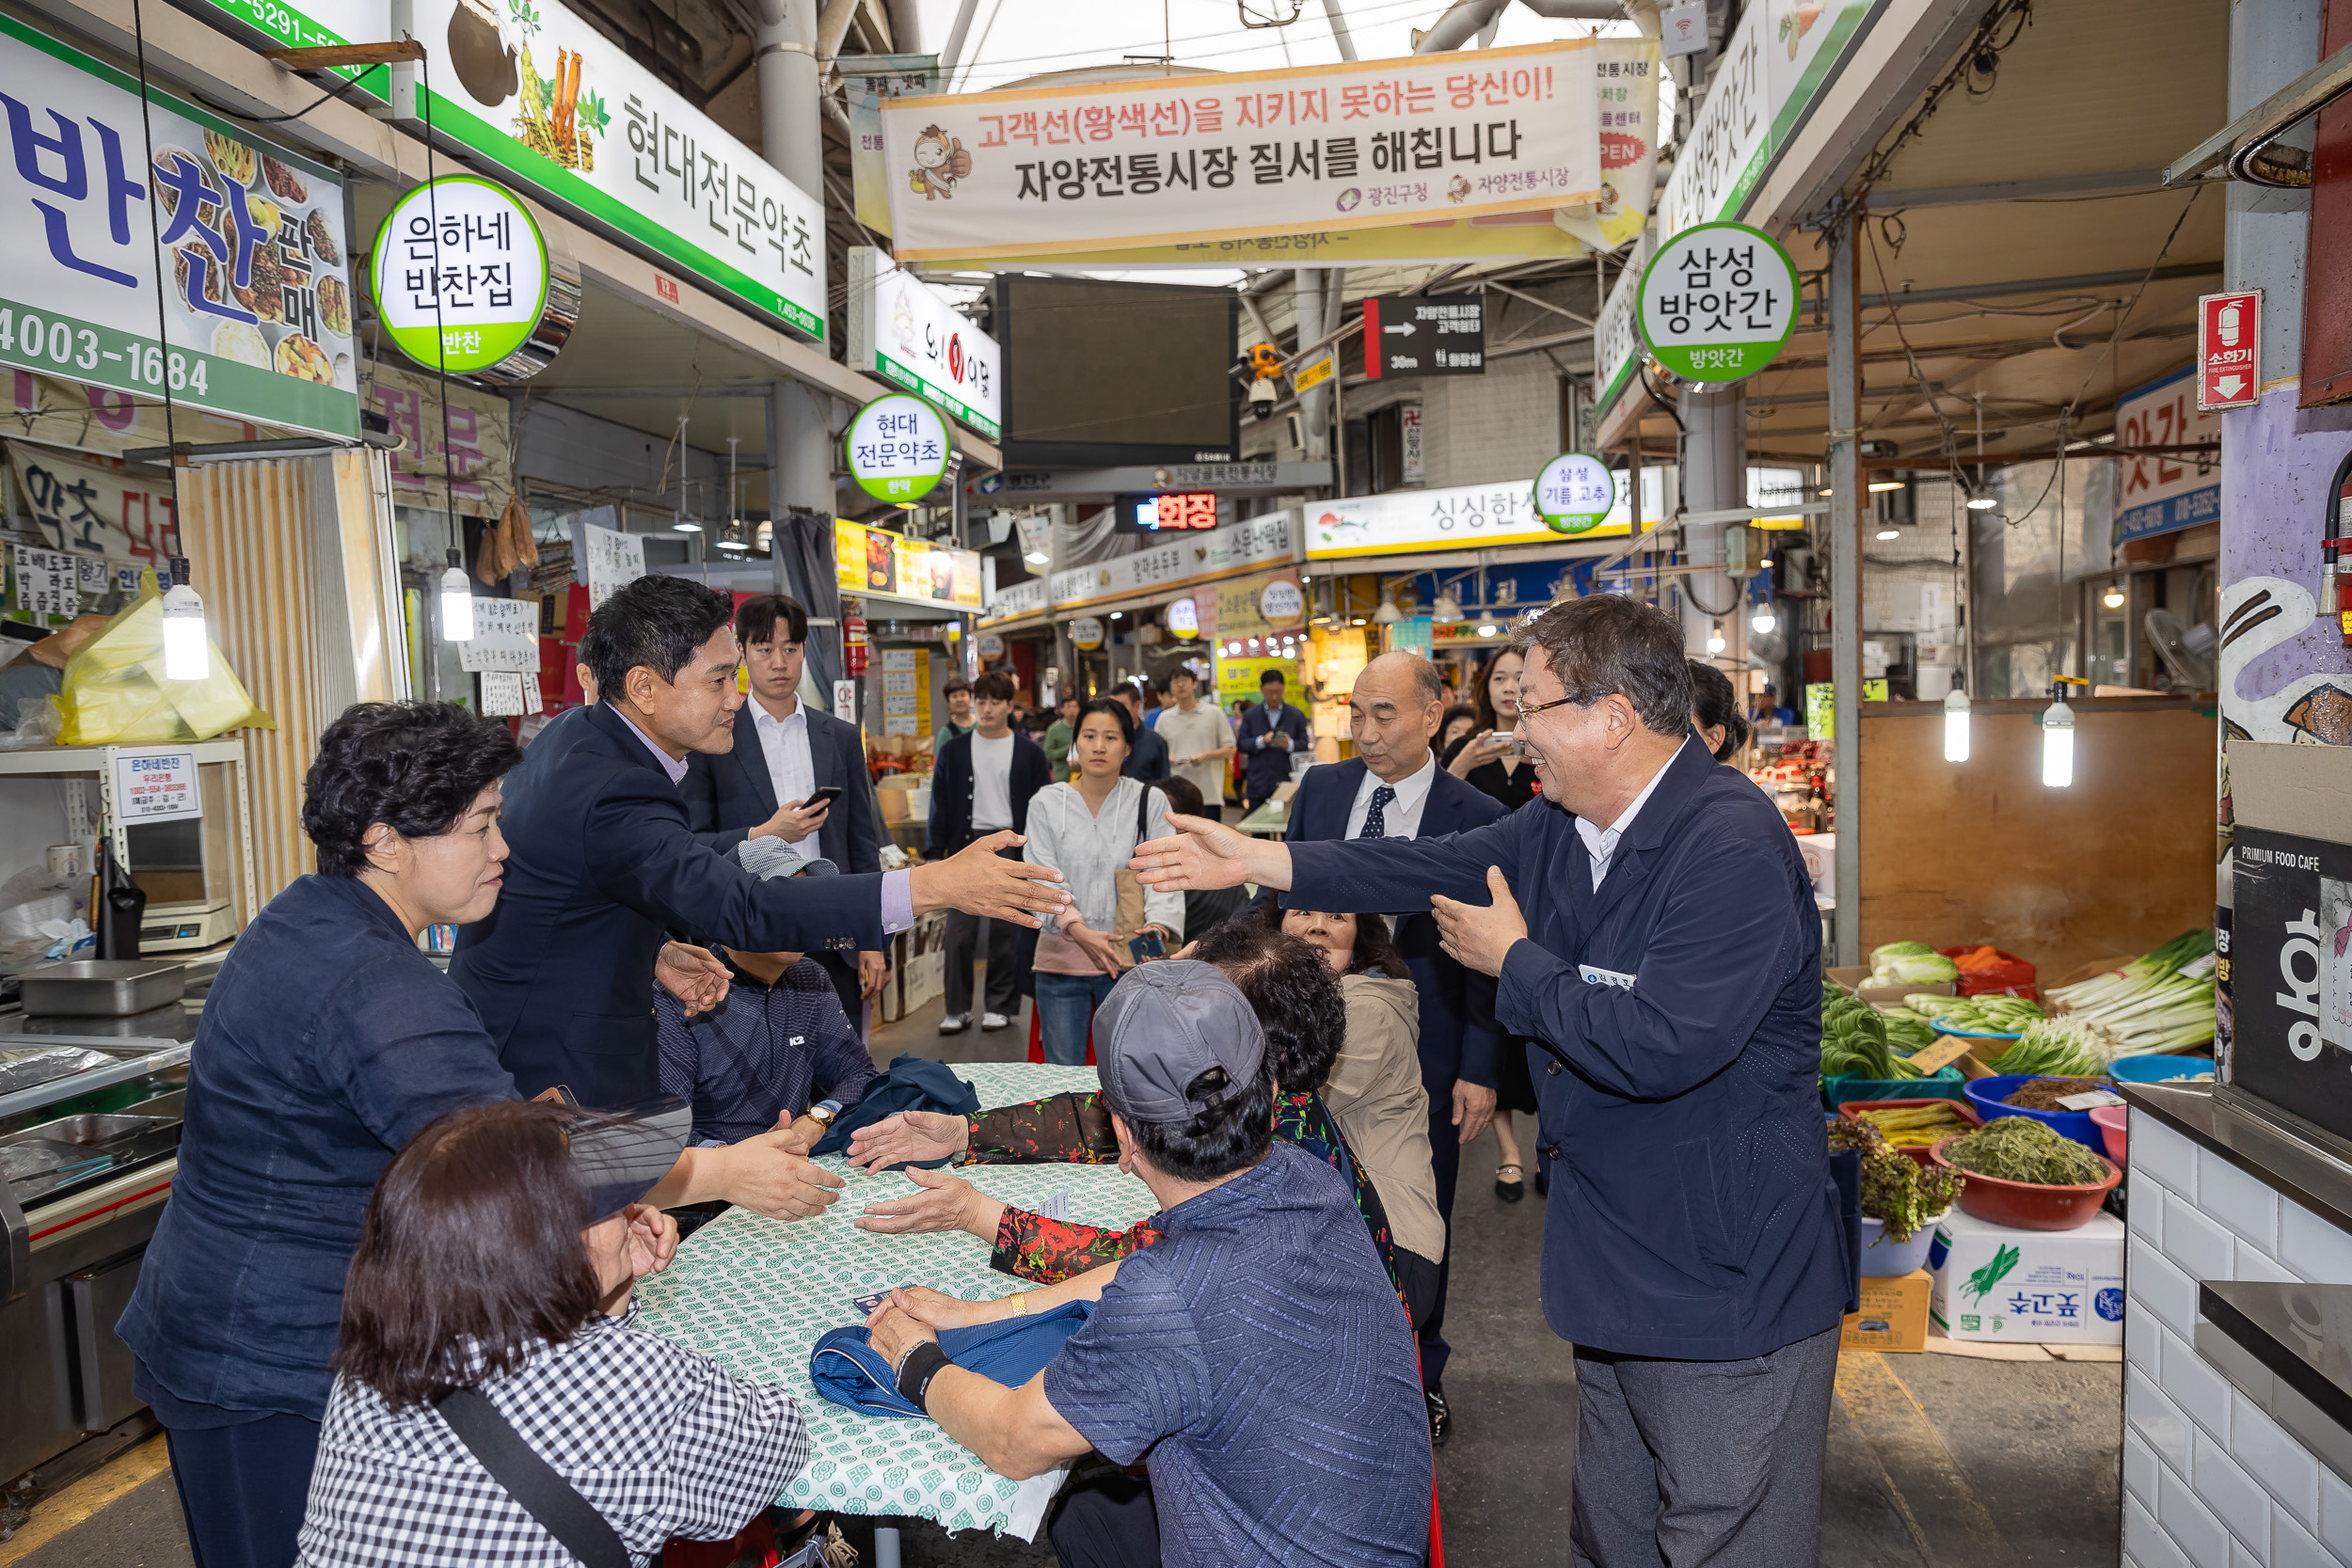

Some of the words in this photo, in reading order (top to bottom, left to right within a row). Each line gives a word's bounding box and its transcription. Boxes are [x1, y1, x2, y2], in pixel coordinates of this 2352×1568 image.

[1597, 61, 1648, 77] 전통시장
[977, 96, 1224, 149] 고객선(황색선)을
[1234, 86, 1329, 130] 지키지
[1340, 74, 1436, 120] 못하는
[1446, 66, 1554, 111] 당신이!
[1599, 87, 1628, 102] 차장
[862, 135, 883, 150] 전통
[1599, 144, 1635, 160] PEN
[1015, 143, 1237, 203] 자양전통시장
[1249, 135, 1359, 185] 질서를
[1373, 119, 1522, 174] 해칩니다
[623, 92, 816, 279] 현대전문약초
[1367, 182, 1428, 207] 광진구청
[1477, 166, 1570, 195] 자양전통시장
[2, 99, 270, 326] 반찬
[403, 212, 512, 260] 은하네
[278, 213, 322, 343] 판매
[1678, 245, 1756, 287] 삼성
[404, 261, 514, 310] 반찬집
[1660, 289, 1777, 335] 방앗간
[0, 308, 209, 396] 4003-1684
[441, 331, 482, 356] 반찬
[1690, 347, 1743, 369] 방앗간
[2208, 348, 2252, 366] 소화기
[1391, 356, 1418, 369] 30m
[877, 413, 917, 439] 현대
[857, 440, 941, 468] 전문약초
[25, 465, 106, 552] 약초
[1158, 494, 1216, 530] 화장
[2242, 846, 2273, 864] PRIMIUM
[2275, 851, 2296, 867] FOOD
[2297, 854, 2320, 872] CAFE
[789, 1036, 805, 1047] K2
[2008, 1291, 2079, 1318] 풋고추
